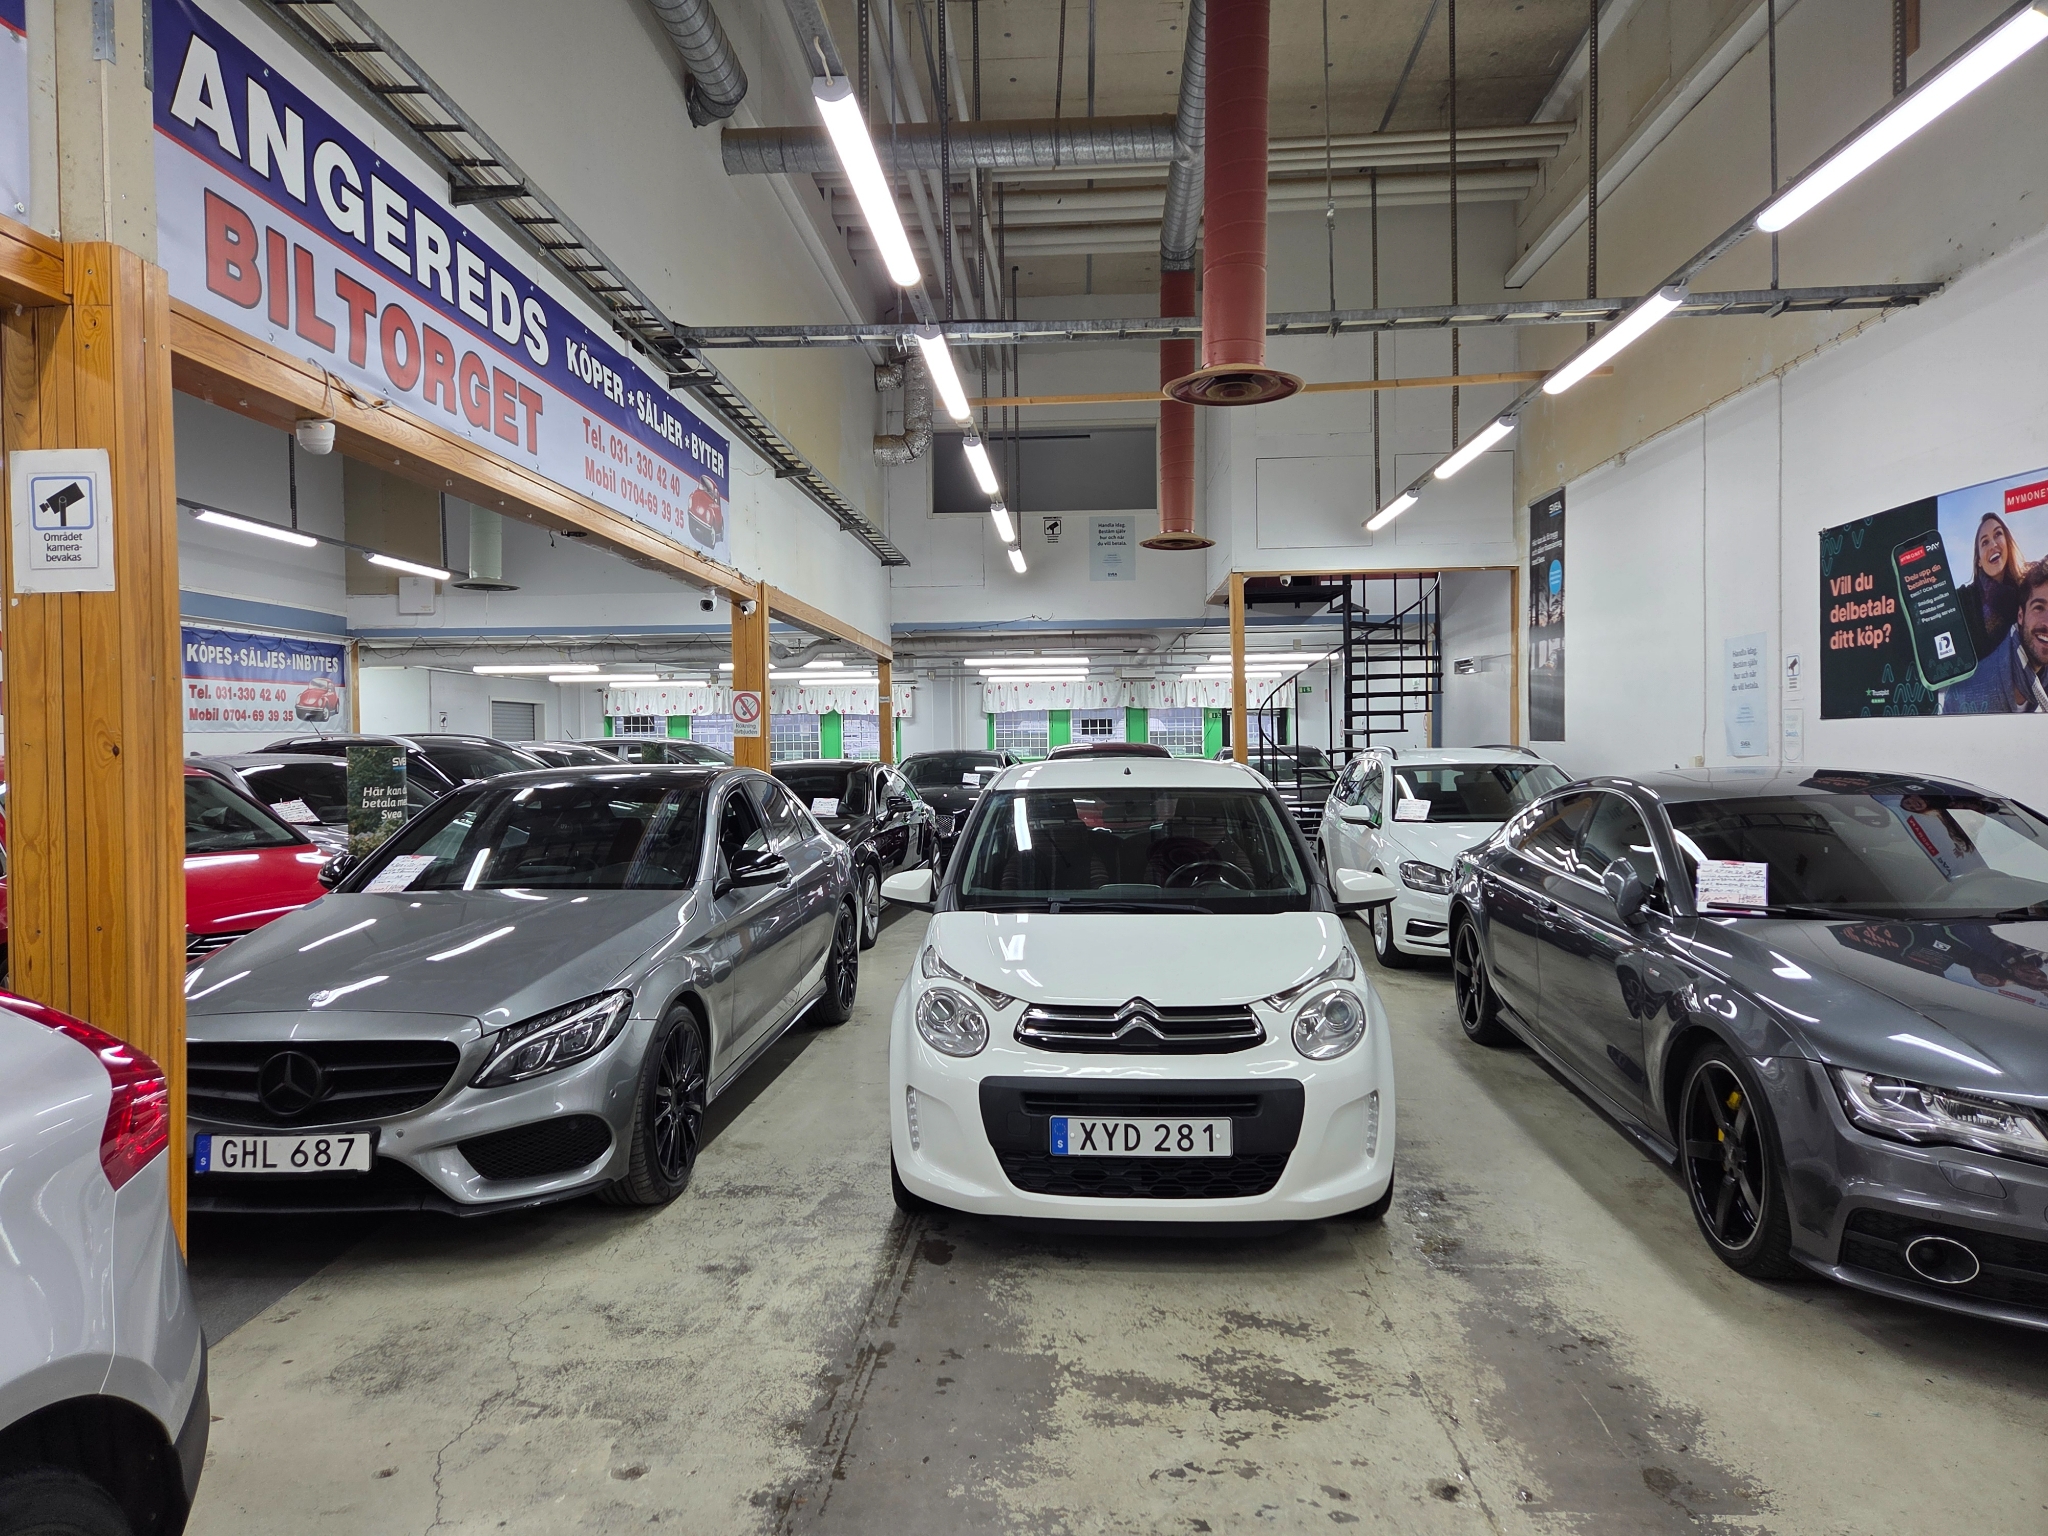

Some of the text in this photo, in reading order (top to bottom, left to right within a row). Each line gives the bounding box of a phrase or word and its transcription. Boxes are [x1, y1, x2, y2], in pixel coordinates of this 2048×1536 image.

[169, 31, 549, 367] ANGEREDS
[203, 186, 543, 456] BILTORGET
[565, 337, 725, 479] KÖPER SÄLJER BYTER
[582, 416, 680, 497] Tel. 031- 330 42 40
[584, 456, 684, 529] Mobil 0704-69 39 35
[43, 532, 82, 541] Området
[46, 543, 82, 551] kamera-
[45, 553, 82, 562] bevakas
[1829, 572, 1873, 597] Vill du
[1830, 595, 1895, 624] delbetala
[1830, 623, 1892, 650] ditt köp?
[186, 641, 339, 673] KÖPES SÄLJES INBYTES
[189, 684, 286, 702] Tel. 031-330 42 40
[189, 708, 294, 722] Mobil 0704-69 39 35
[362, 798, 396, 808] betala
[363, 787, 385, 796] Här
[387, 786, 401, 796] kan
[381, 810, 402, 819] Svea
[1057, 1139, 1063, 1148] S
[1079, 1122, 1214, 1152] XYD 281
[200, 1157, 207, 1165] S
[221, 1137, 355, 1168] GHL 687
